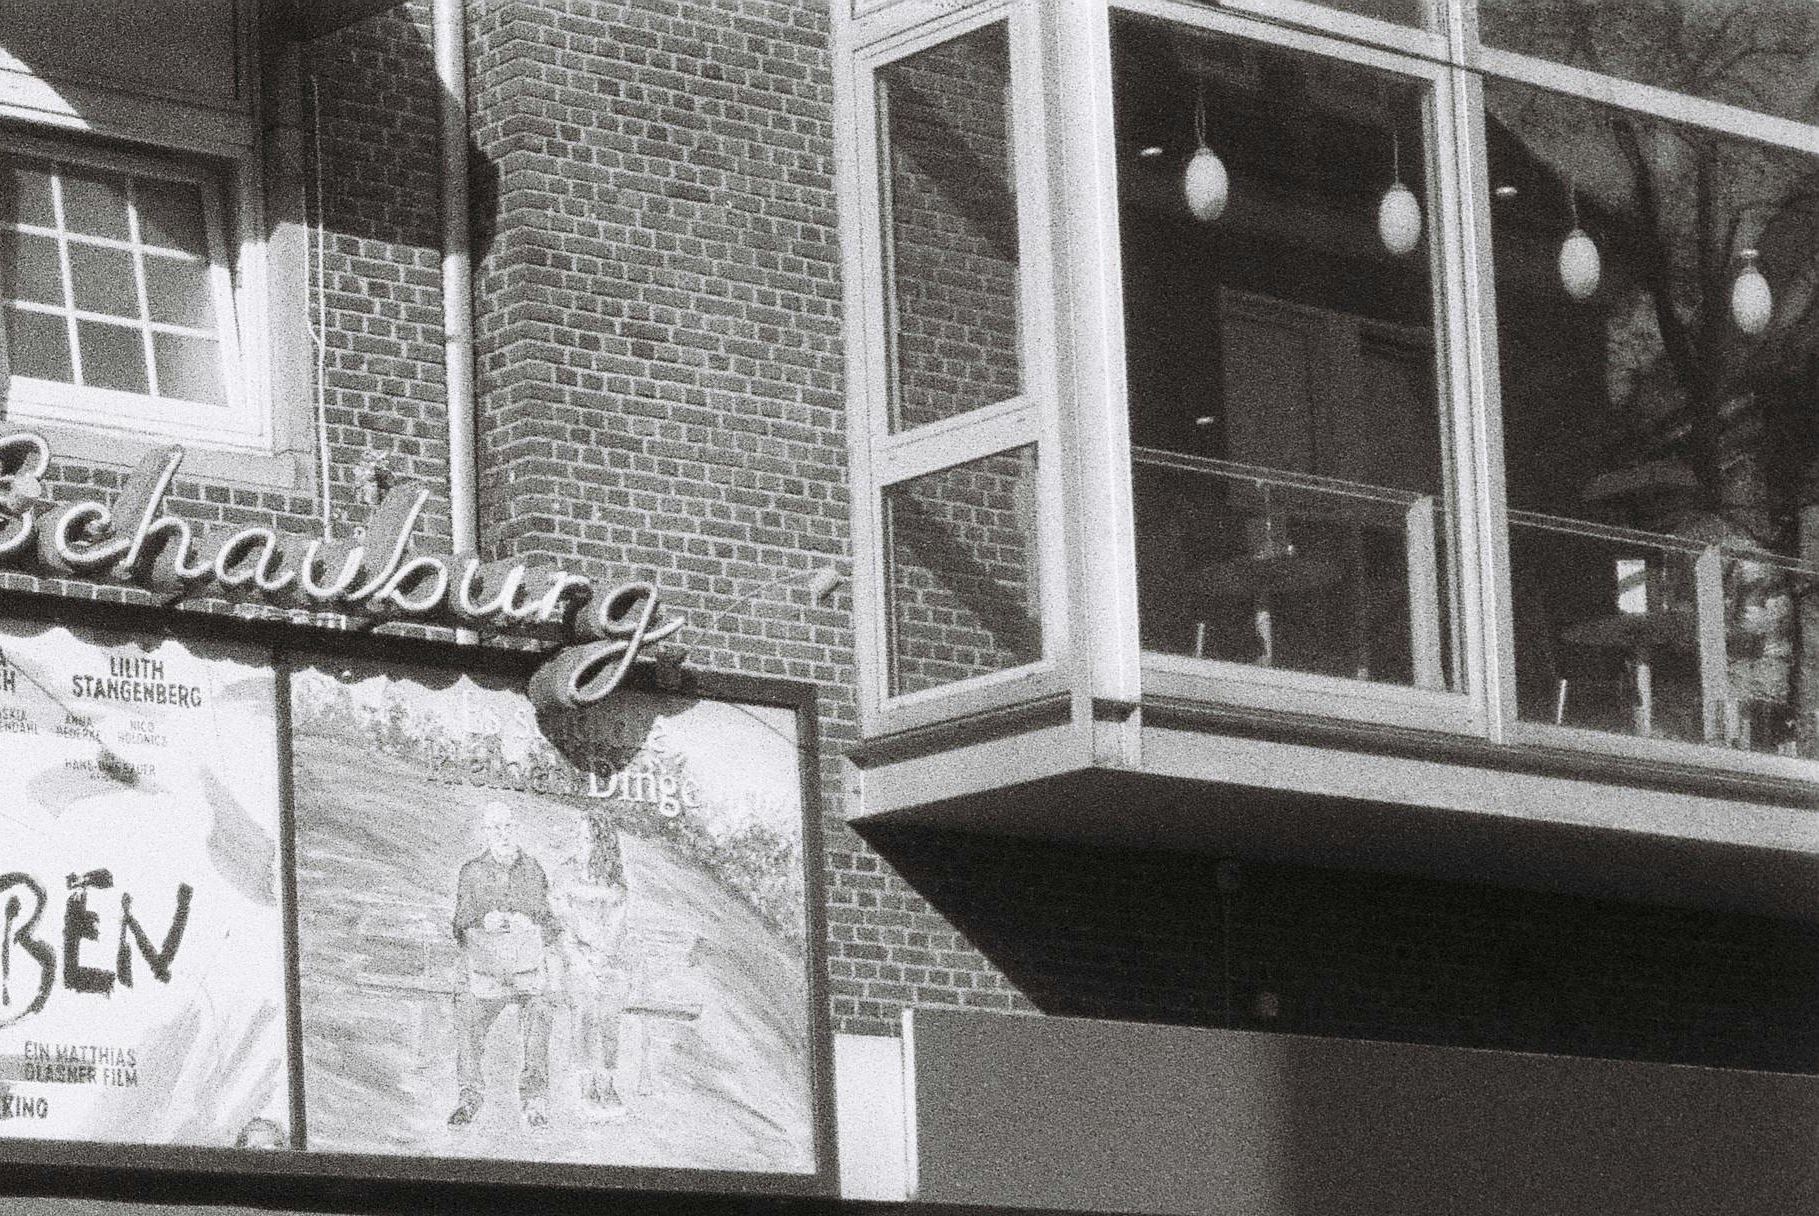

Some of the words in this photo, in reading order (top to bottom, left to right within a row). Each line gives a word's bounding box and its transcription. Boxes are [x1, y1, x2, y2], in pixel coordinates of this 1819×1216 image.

[110, 656, 165, 681] LILITH
[72, 674, 203, 709] STANGENBERG
[25, 1040, 50, 1061] EIN
[57, 1044, 138, 1069] MATTHIAS
[103, 1066, 139, 1088] FILM
[0, 1094, 49, 1120] KINO
